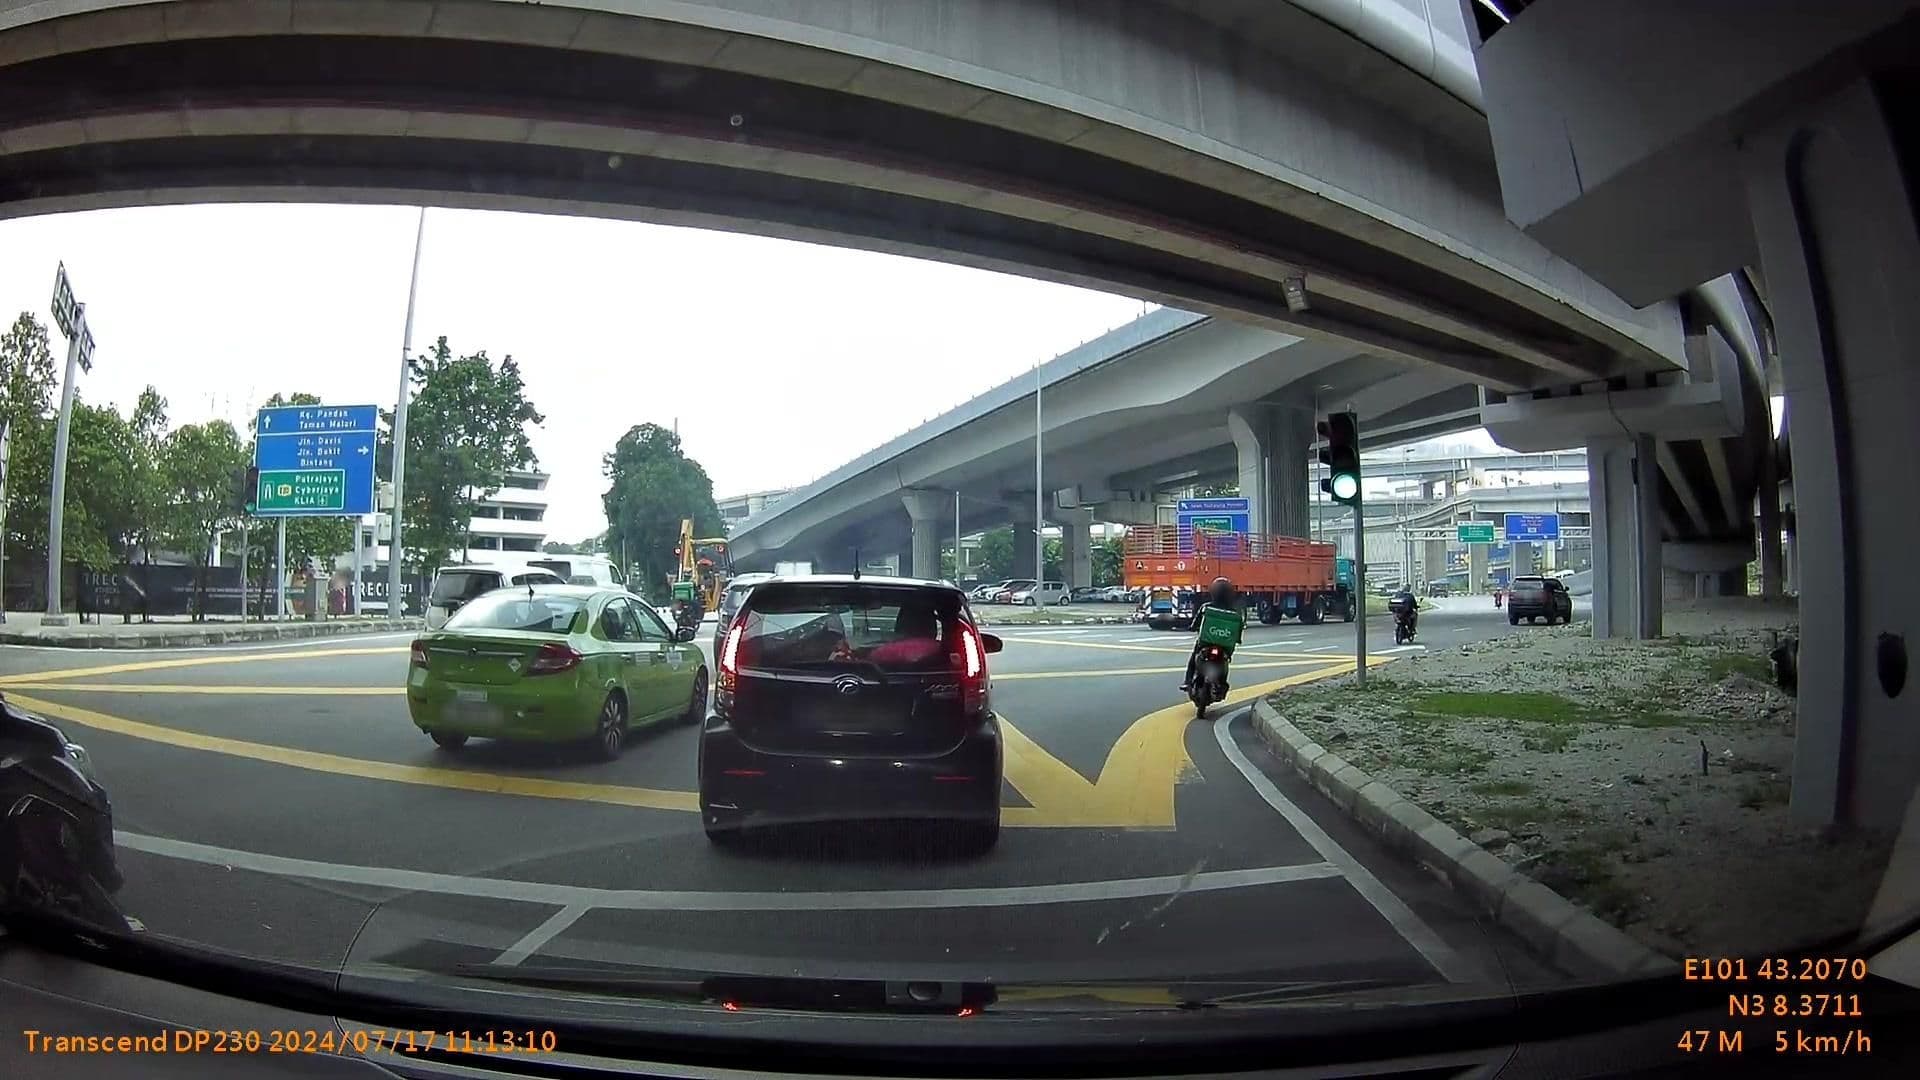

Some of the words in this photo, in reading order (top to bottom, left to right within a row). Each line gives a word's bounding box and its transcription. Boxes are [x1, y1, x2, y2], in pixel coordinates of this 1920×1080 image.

[299, 410, 313, 420] Kg.
[317, 409, 348, 418] Pandan
[299, 420, 326, 430] Taman
[298, 438, 314, 446] Jln.
[297, 448, 313, 456] Jln.
[317, 447, 341, 456] Bukit
[300, 458, 333, 468] Bintang
[295, 475, 338, 484] Putrajaya
[295, 485, 339, 496] Cyberjaya
[294, 496, 315, 505] KLIA
[81, 572, 118, 586] TREC
[1209, 626, 1232, 638] Grab
